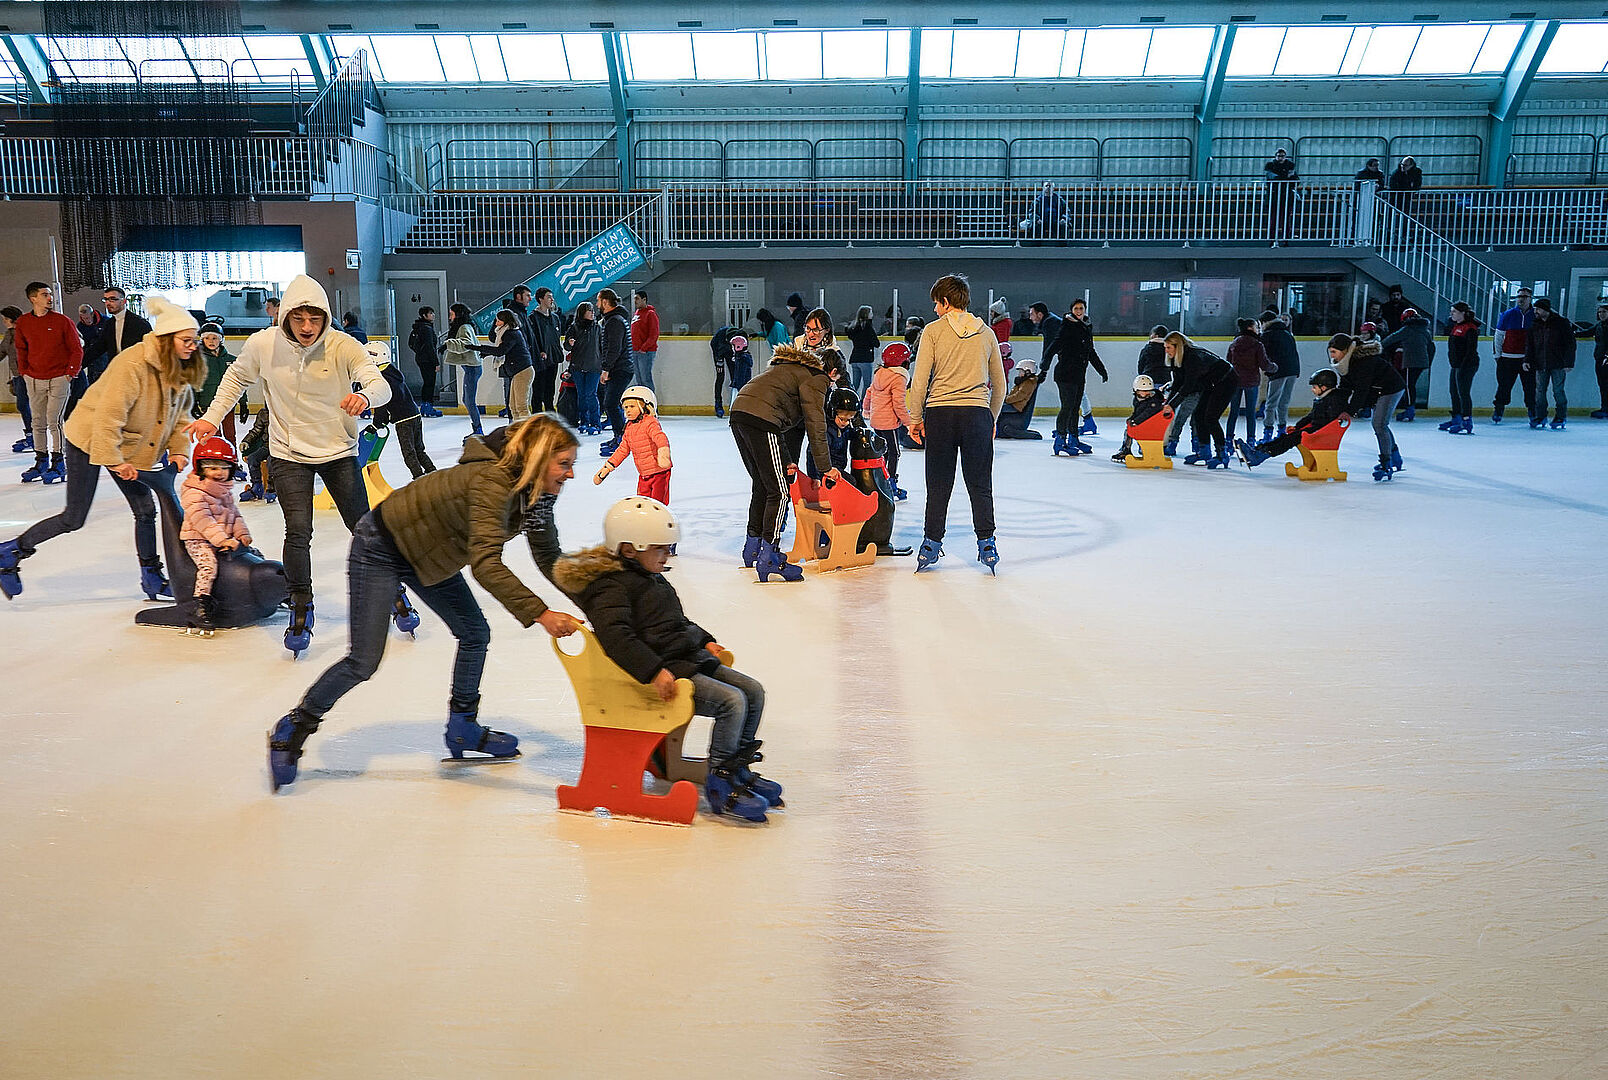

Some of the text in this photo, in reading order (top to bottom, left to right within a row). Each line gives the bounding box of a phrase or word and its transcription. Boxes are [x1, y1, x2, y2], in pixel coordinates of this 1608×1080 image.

[590, 227, 623, 255] SAINT
[595, 237, 630, 264] BRIEUC
[602, 247, 636, 274] ARMOR
